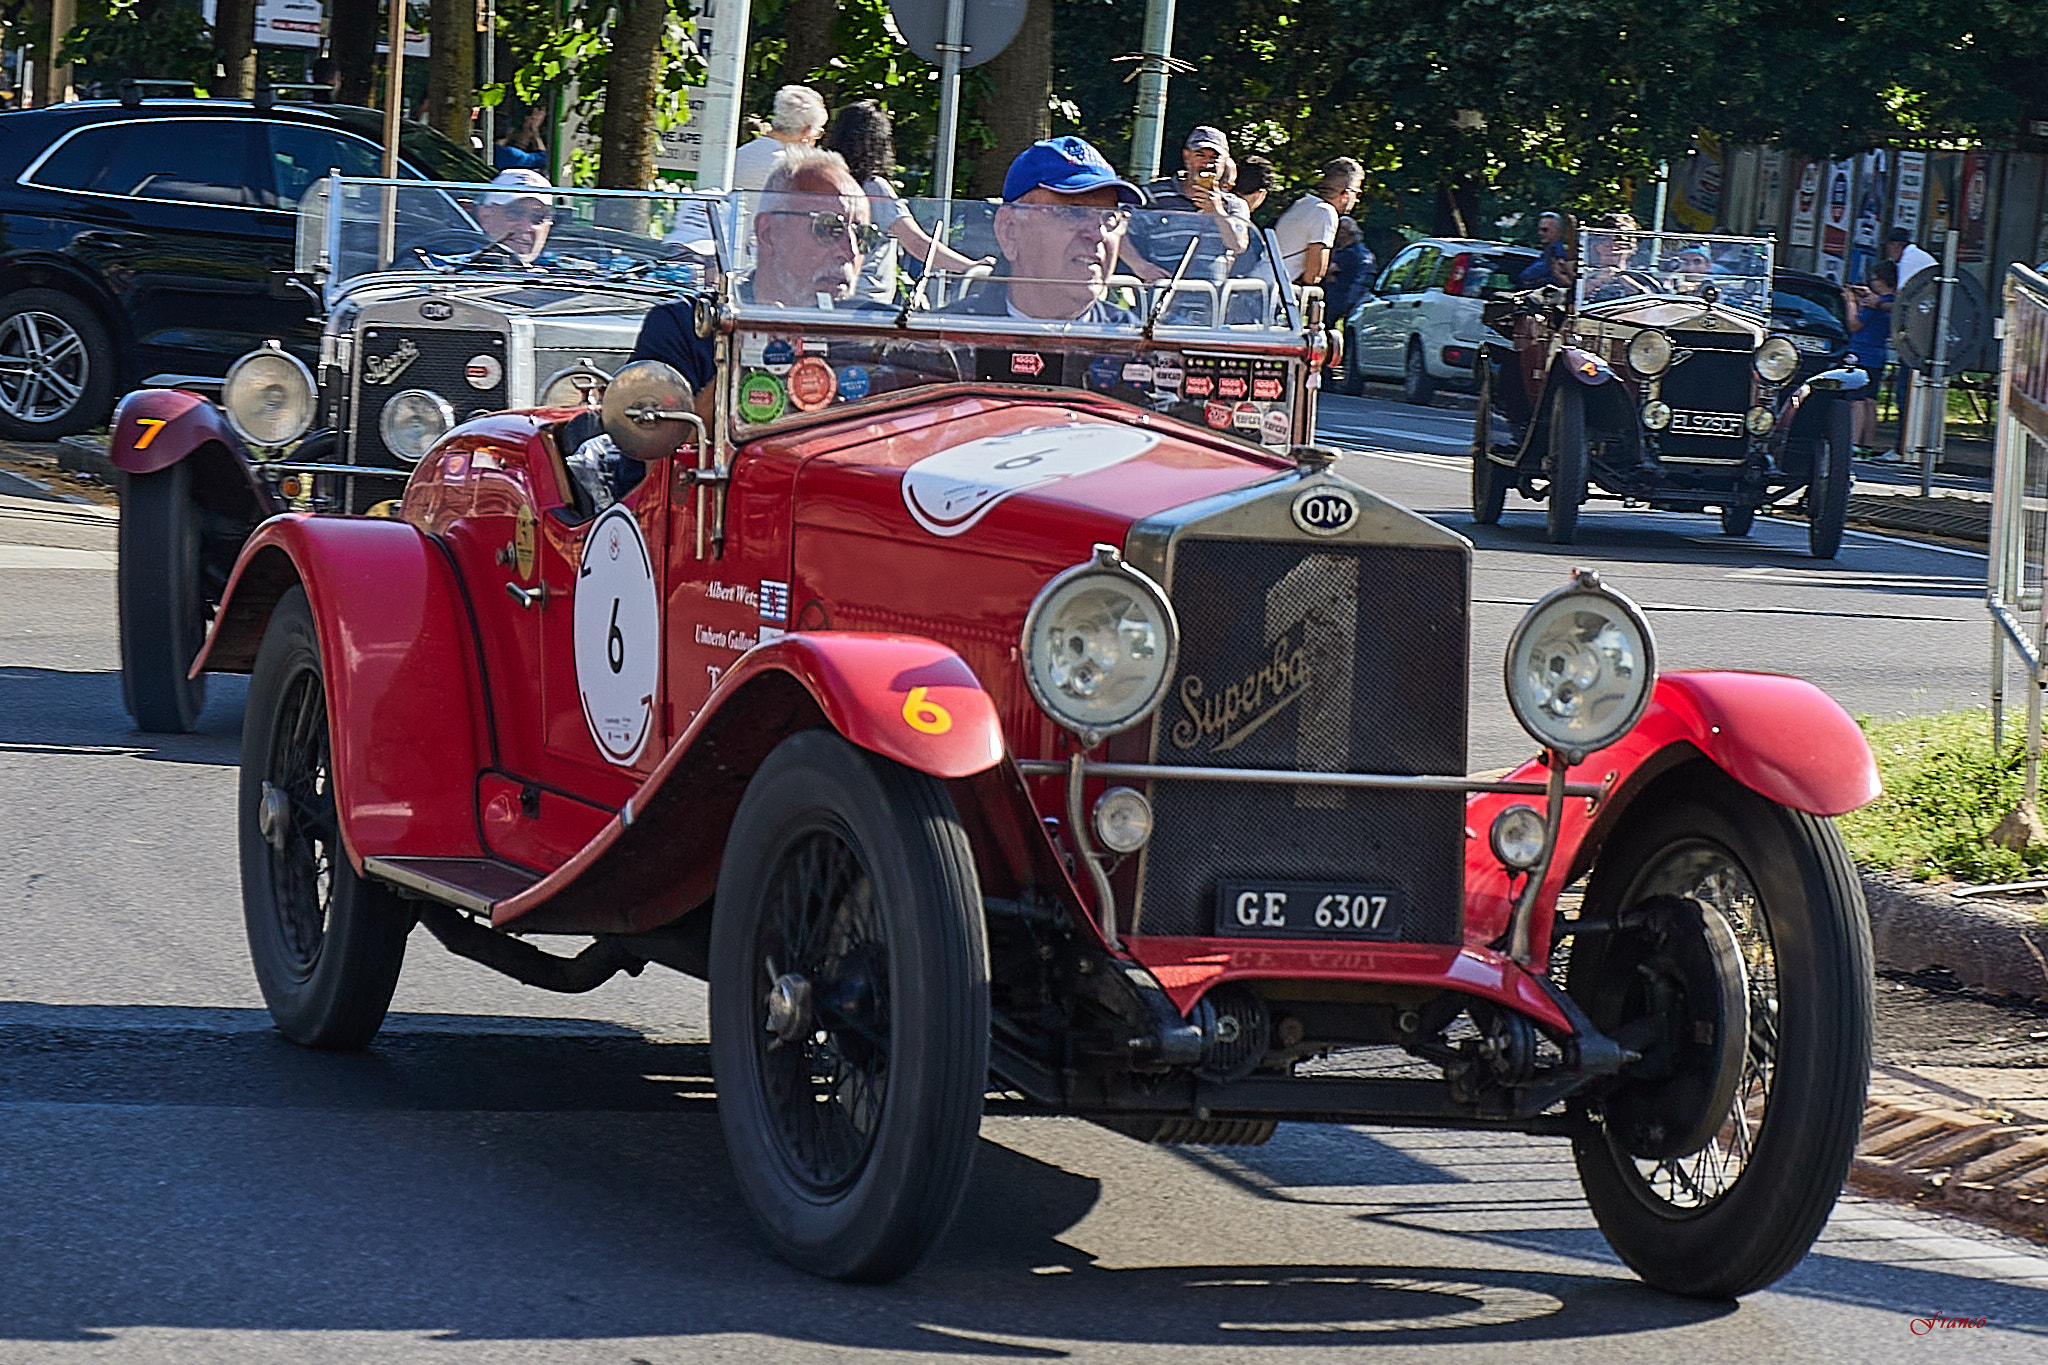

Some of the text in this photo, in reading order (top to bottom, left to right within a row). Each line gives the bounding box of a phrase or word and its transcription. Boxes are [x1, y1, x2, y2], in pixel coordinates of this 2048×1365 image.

[133, 418, 168, 450] 7
[1306, 499, 1347, 524] OM
[705, 580, 735, 601] Albert
[607, 598, 624, 674] 6
[695, 624, 727, 648] Umberto
[902, 687, 952, 735] 6
[1172, 637, 1313, 750] Superba
[1236, 891, 1388, 930] GE 6307
